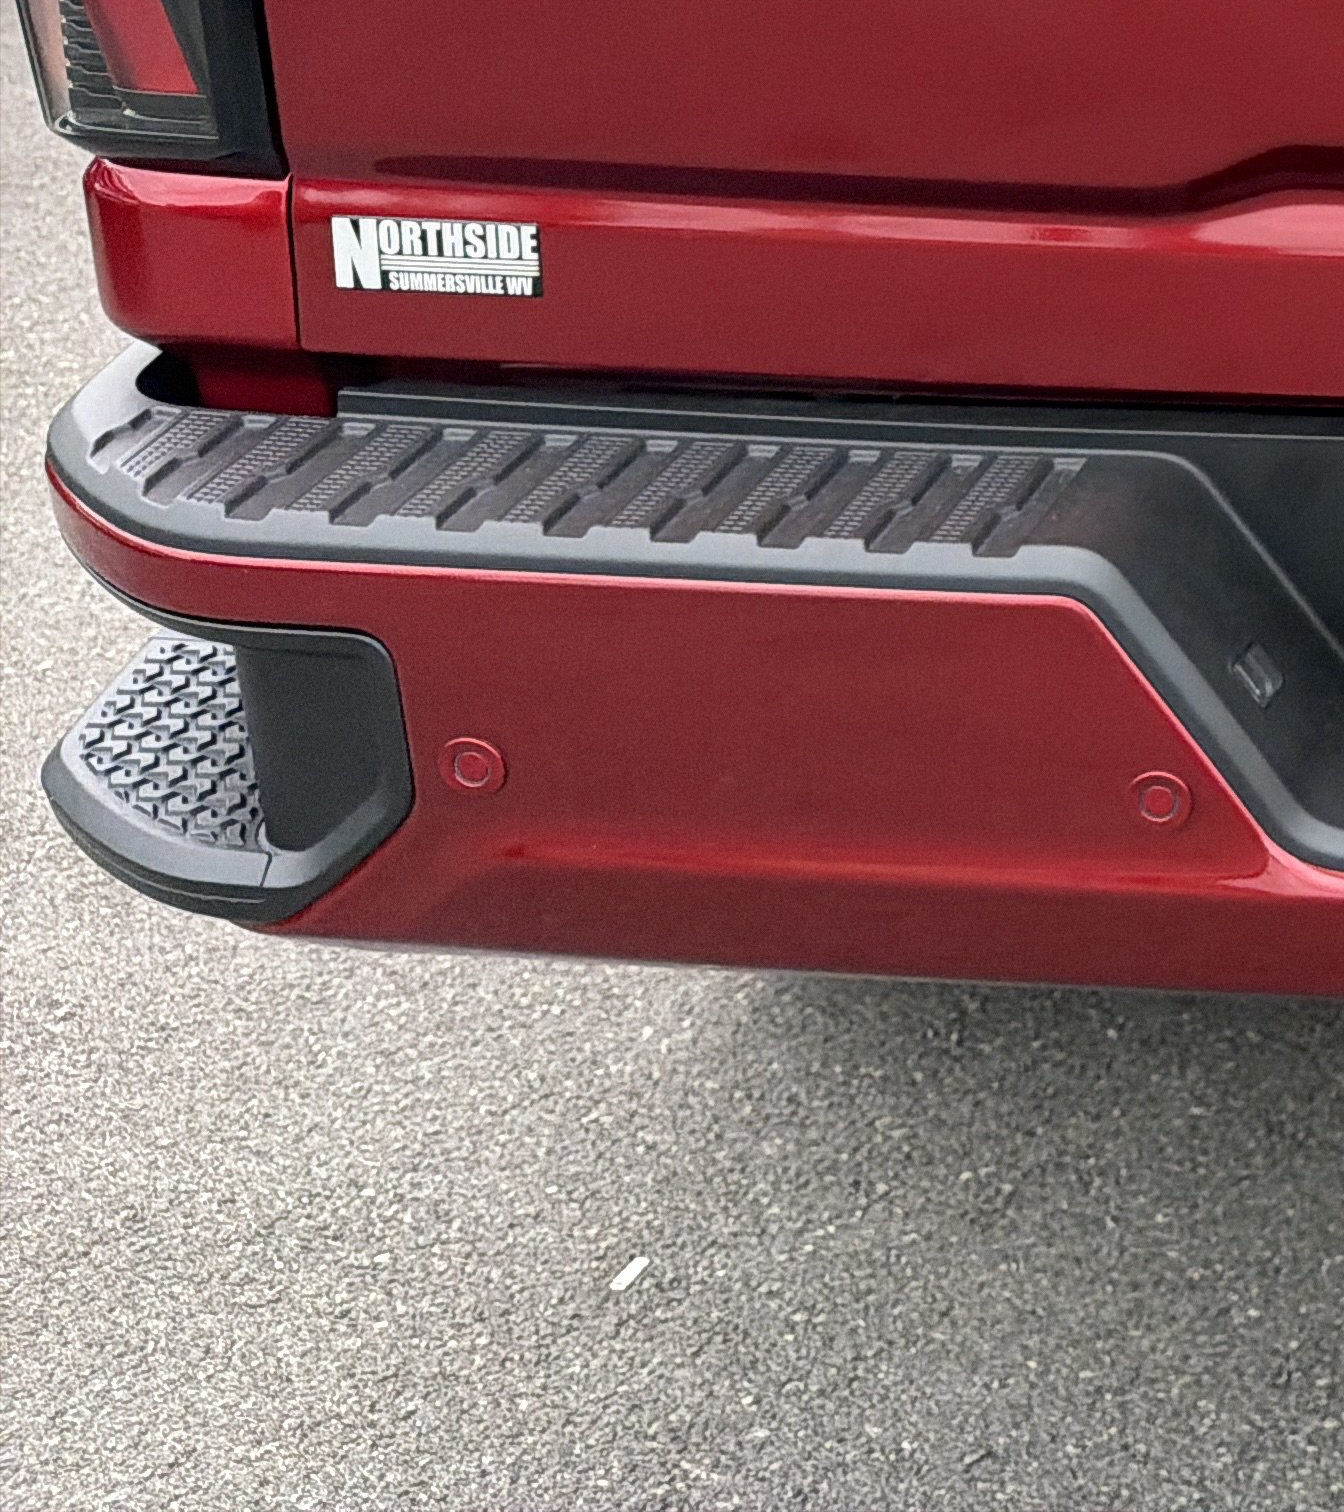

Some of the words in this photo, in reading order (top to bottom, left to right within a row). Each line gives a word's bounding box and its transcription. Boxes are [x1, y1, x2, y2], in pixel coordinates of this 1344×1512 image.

[331, 216, 539, 290] NORTHSIDE
[389, 271, 505, 294] SUMMERSVILLE
[506, 277, 533, 296] WV
